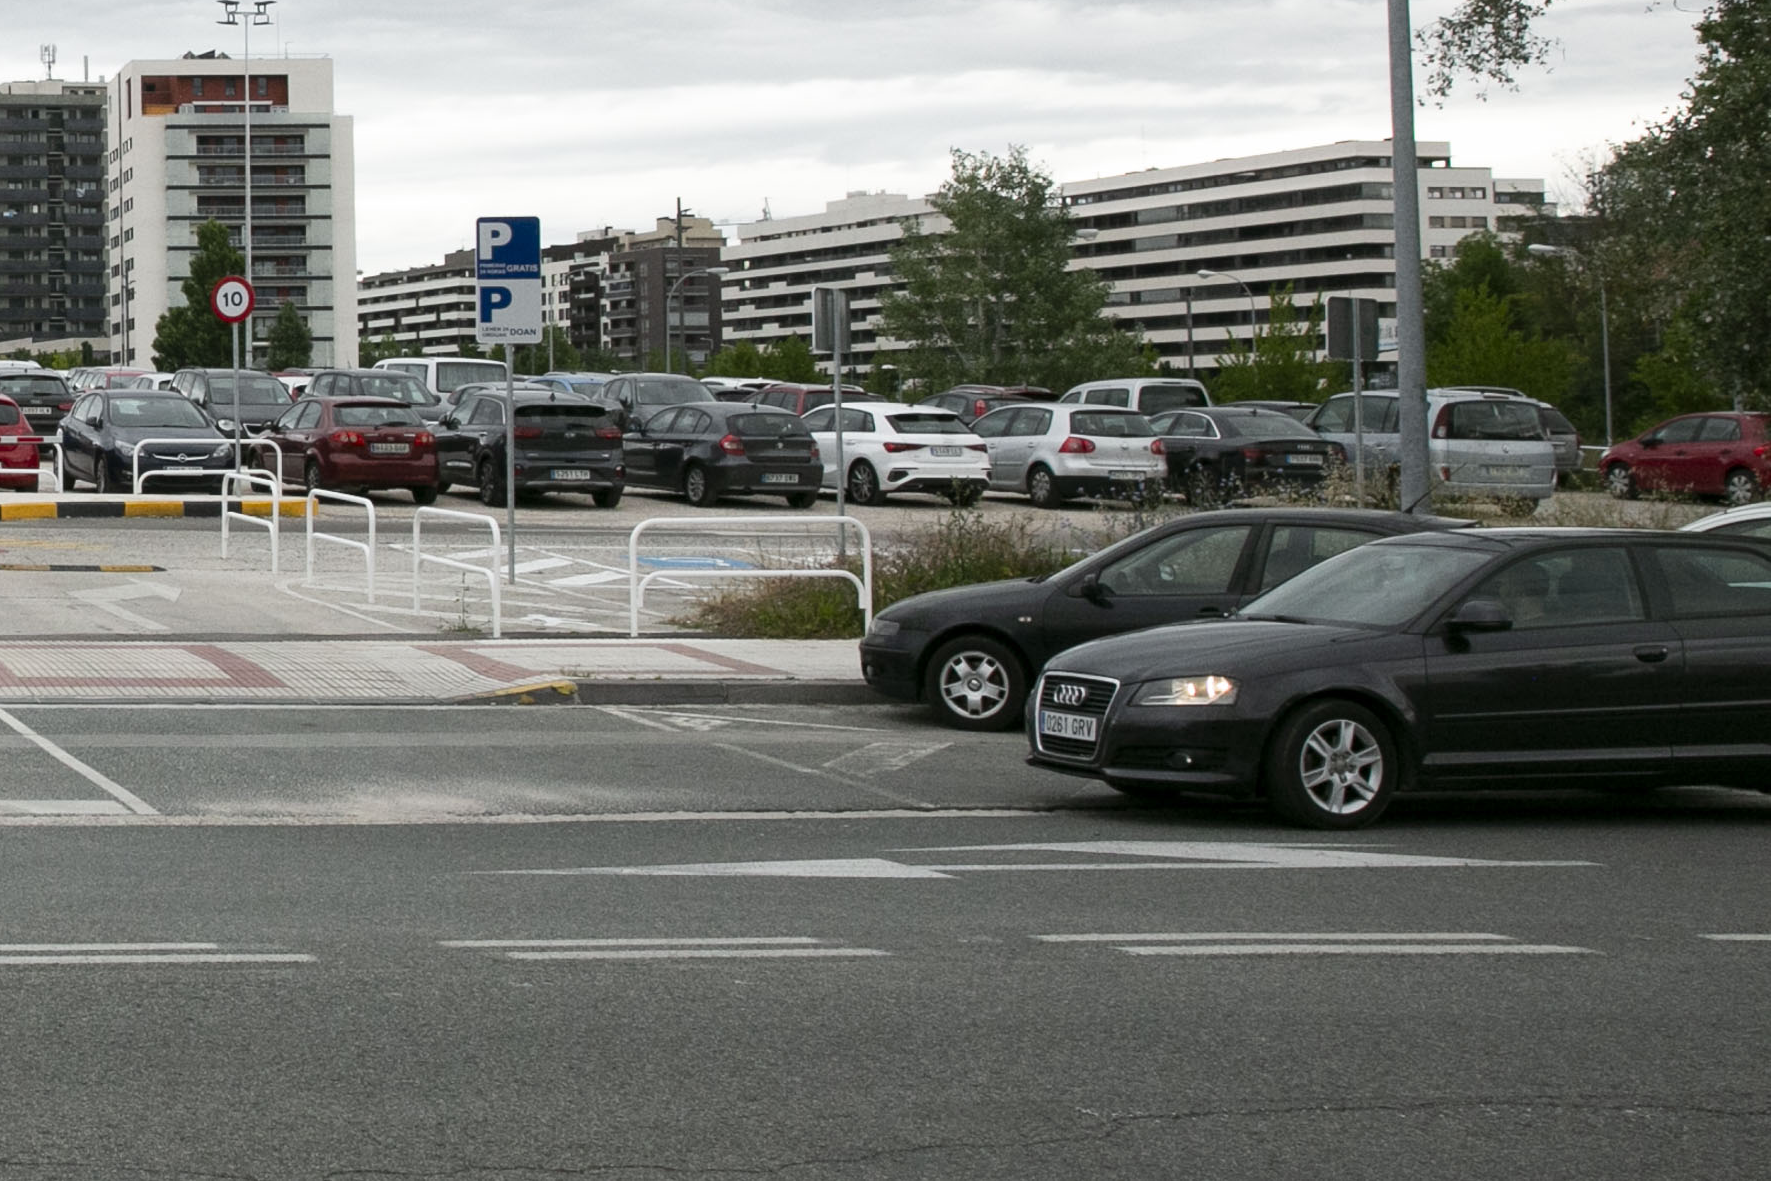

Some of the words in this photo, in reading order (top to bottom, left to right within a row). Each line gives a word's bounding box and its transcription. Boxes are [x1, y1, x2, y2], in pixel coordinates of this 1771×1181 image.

[479, 222, 512, 260] P
[506, 264, 538, 272] GRATIS
[222, 291, 243, 307] 10
[480, 286, 512, 323] P
[510, 328, 536, 336] DOAN
[1047, 714, 1068, 734] 0261
[1072, 717, 1093, 738] GRV
